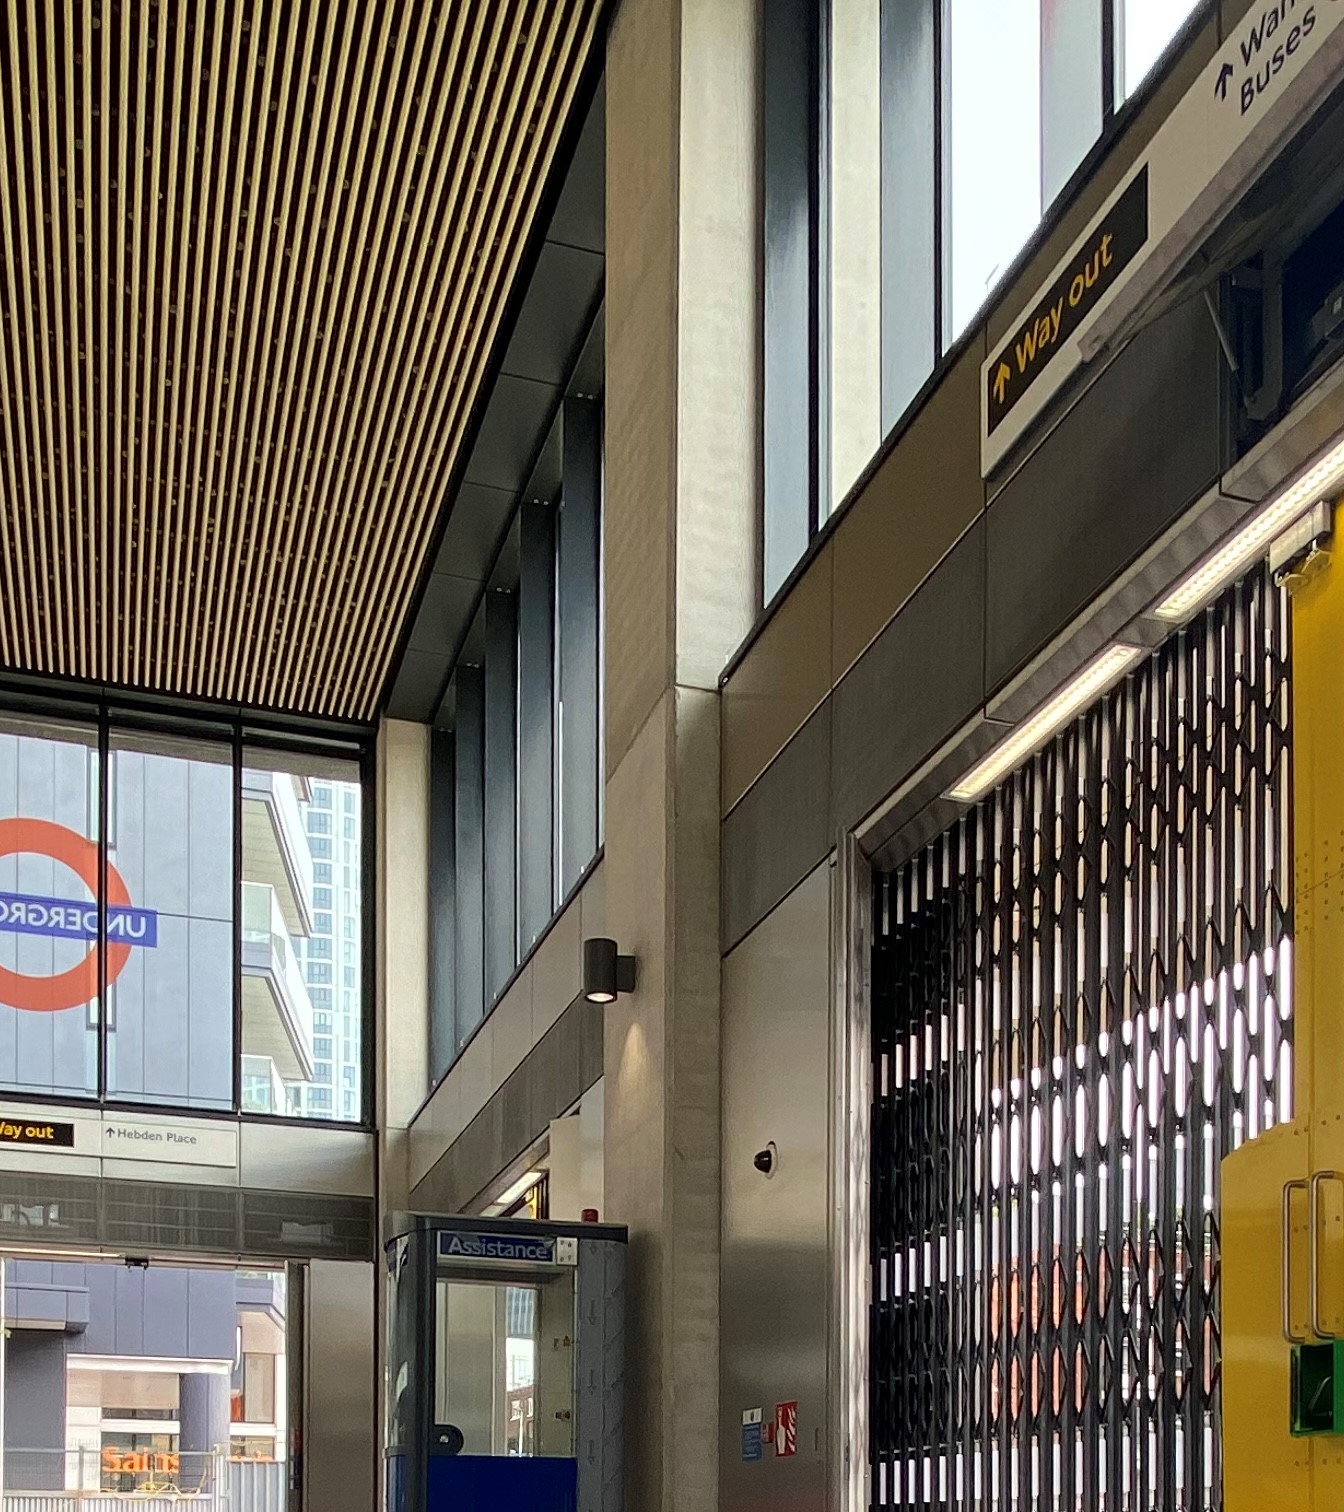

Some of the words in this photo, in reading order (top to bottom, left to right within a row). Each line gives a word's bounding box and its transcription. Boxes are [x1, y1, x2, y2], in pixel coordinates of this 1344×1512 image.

[1241, 6, 1316, 116] Buses
[1016, 296, 1063, 373] Way
[1069, 233, 1113, 307] out
[25, 1126, 54, 1139] out
[117, 1128, 163, 1141] Hebden
[167, 1132, 197, 1144] Place
[449, 1236, 549, 1259] Assistance
